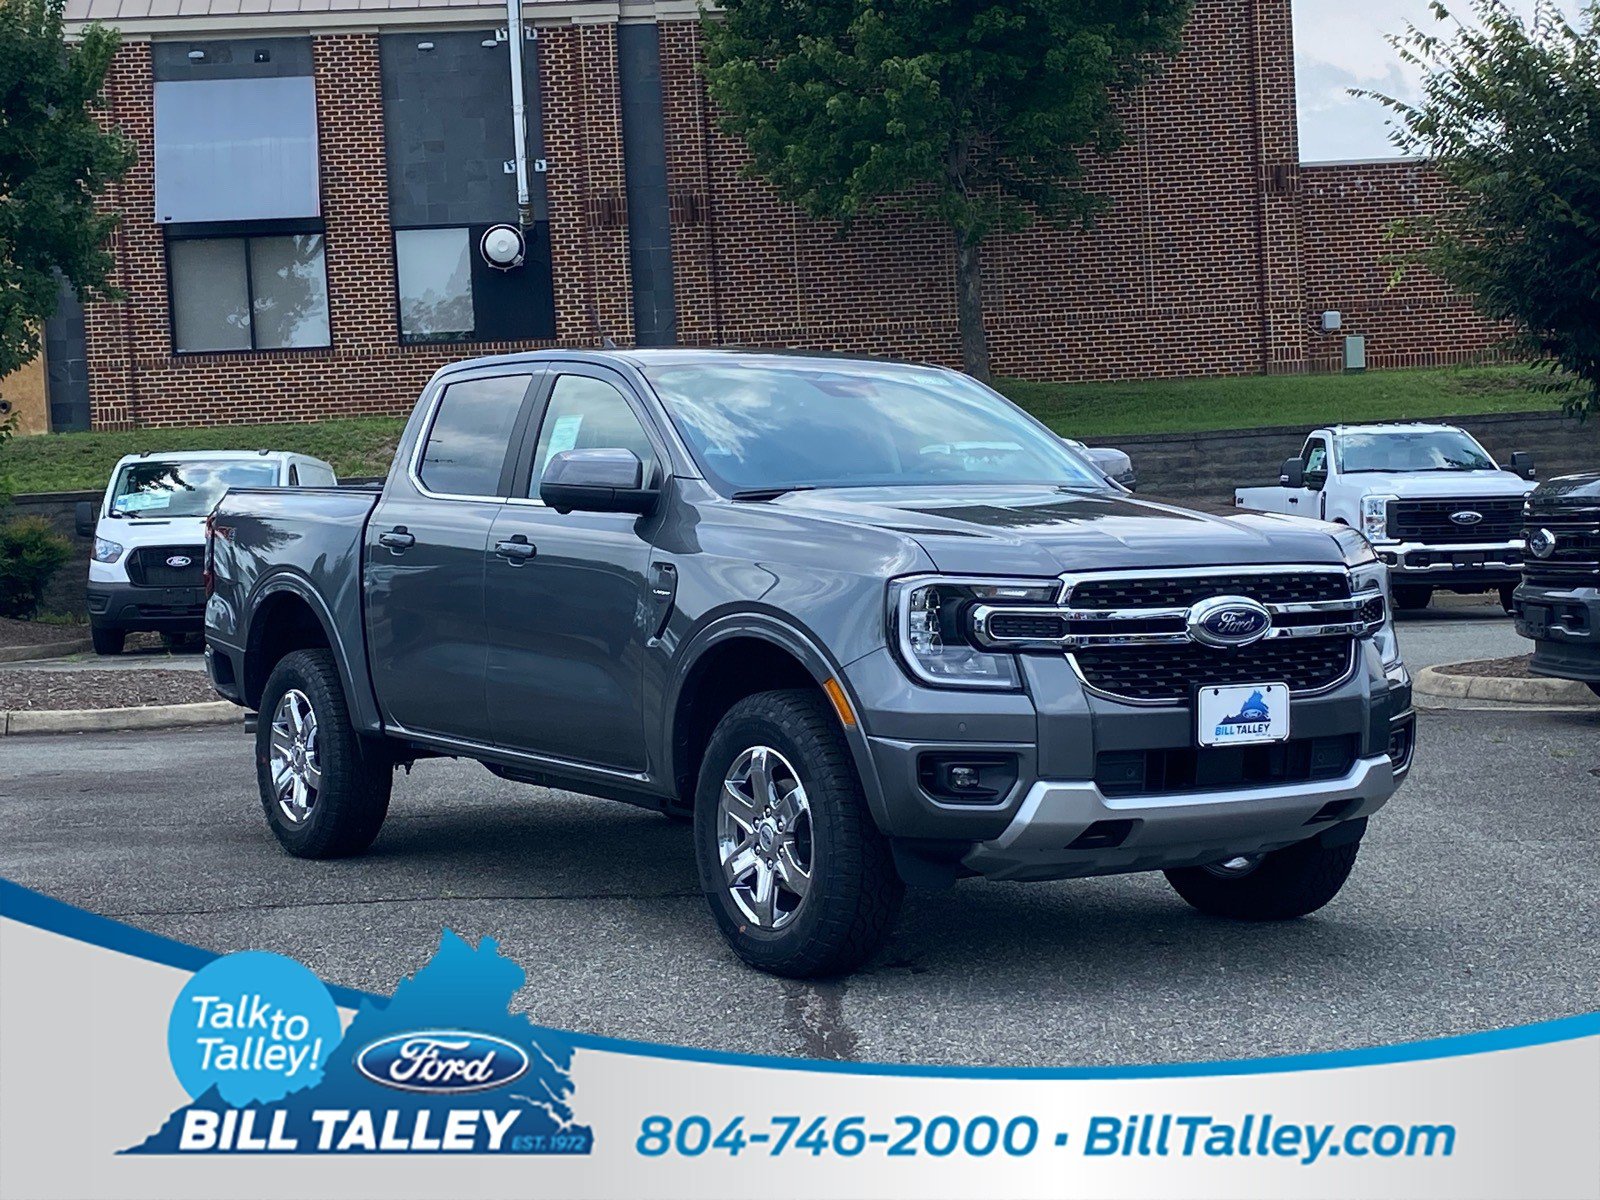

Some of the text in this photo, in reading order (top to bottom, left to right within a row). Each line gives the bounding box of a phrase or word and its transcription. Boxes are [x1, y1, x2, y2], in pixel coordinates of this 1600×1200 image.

[1217, 611, 1255, 633] Ford
[1215, 723, 1271, 736] BILL TALLEY
